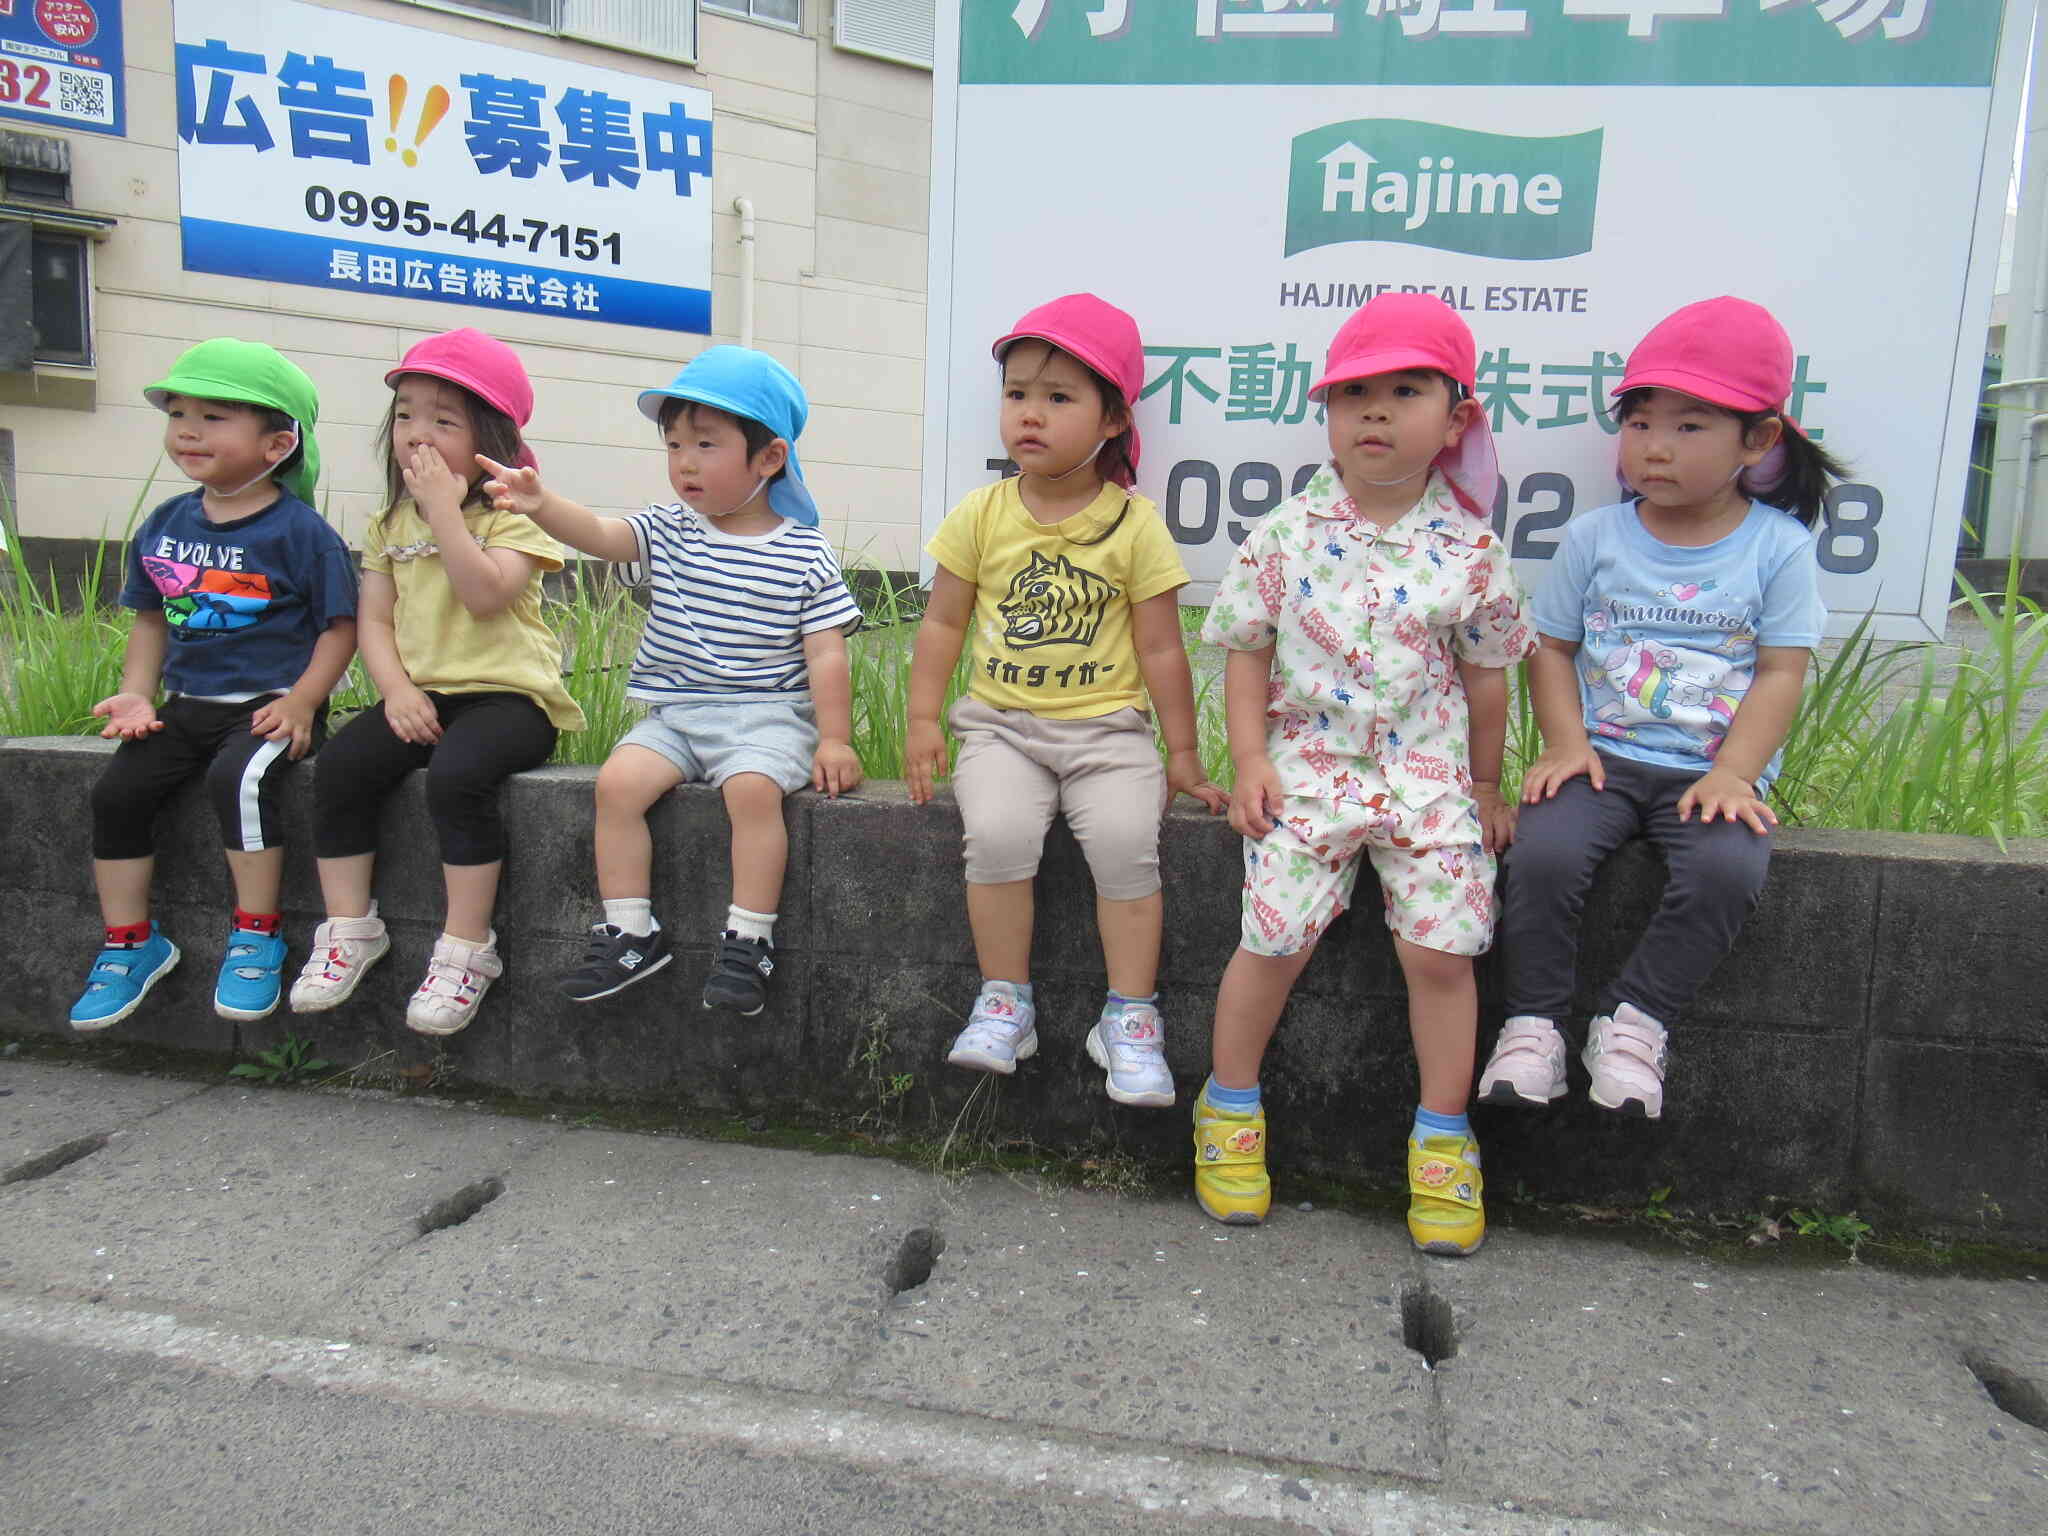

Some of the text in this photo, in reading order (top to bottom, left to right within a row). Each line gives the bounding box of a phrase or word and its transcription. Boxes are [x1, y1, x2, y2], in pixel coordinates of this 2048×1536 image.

[1316, 140, 1563, 231] Hajime
[305, 184, 622, 265] 0995-44-7151
[329, 248, 600, 313] 長田広告株式会社
[1484, 286, 1589, 313] ESTATE
[156, 535, 244, 571] EVOLVE
